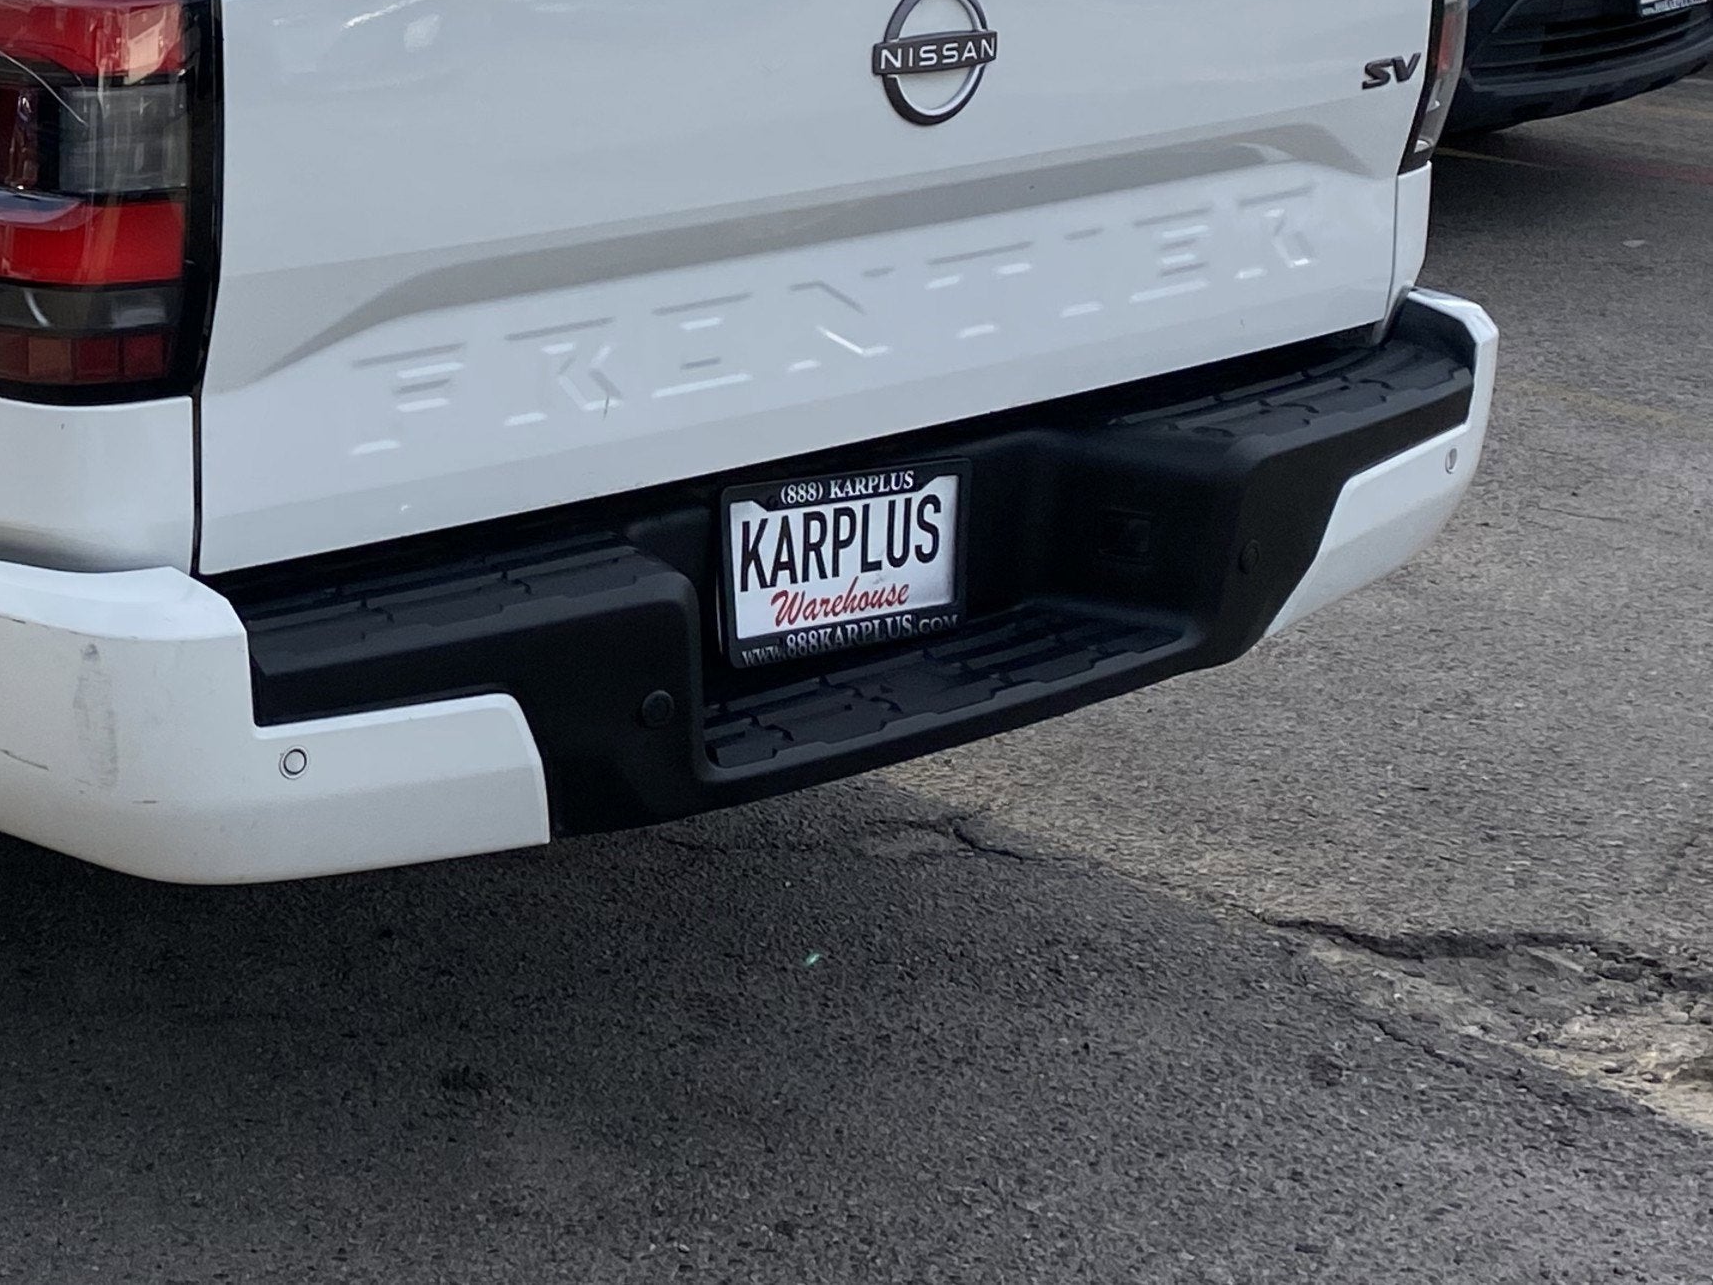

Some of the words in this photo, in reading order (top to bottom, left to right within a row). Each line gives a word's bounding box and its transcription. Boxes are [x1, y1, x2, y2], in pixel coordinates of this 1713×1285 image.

[880, 36, 996, 70] NISSAN
[1362, 52, 1422, 90] SV
[349, 182, 1317, 457] FRONTIER
[780, 481, 824, 505] (888)
[828, 470, 915, 499] KARPLUS
[739, 493, 942, 593] KARPLUS
[770, 575, 910, 628] Warehouse
